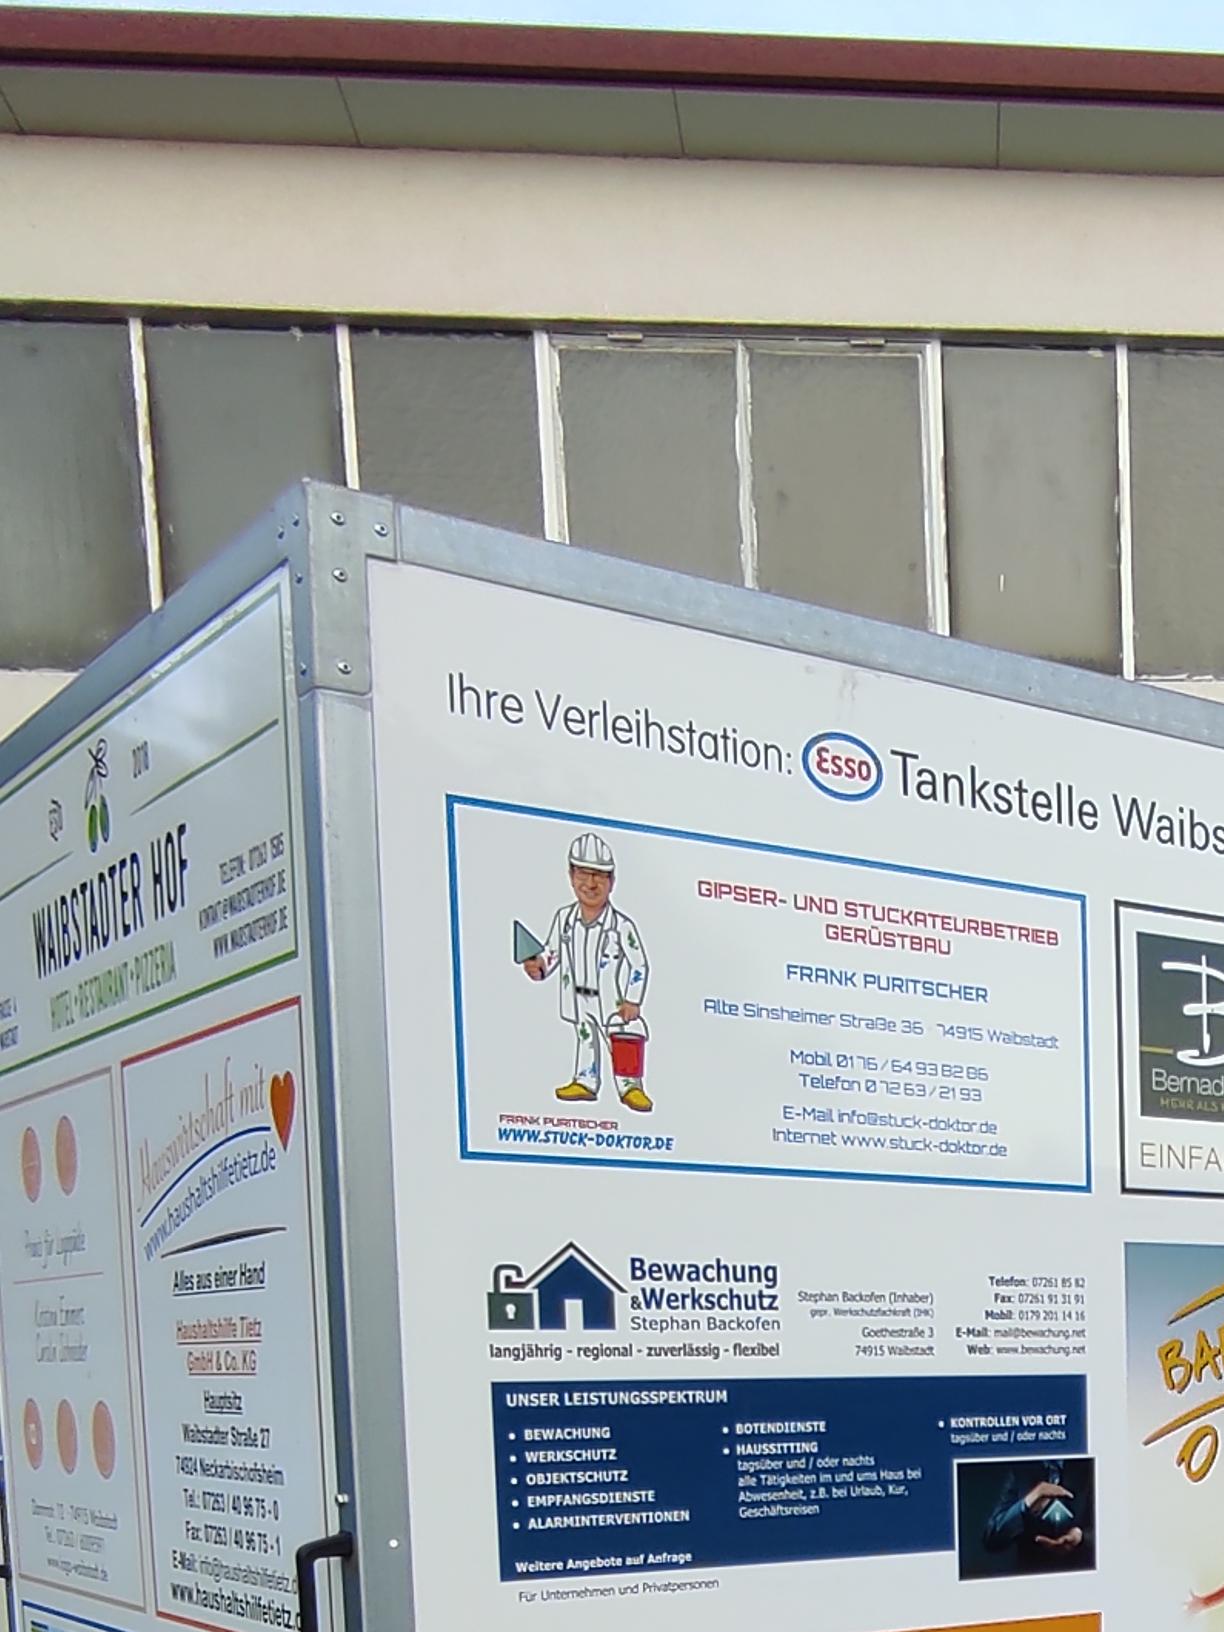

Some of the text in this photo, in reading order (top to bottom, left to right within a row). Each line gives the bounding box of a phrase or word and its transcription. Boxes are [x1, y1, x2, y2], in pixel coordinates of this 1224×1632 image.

[449, 672, 524, 723] Ihre
[535, 689, 793, 776] Verleihstation:
[891, 749, 1099, 830] Tankstelle
[32, 823, 188, 980] WAIBSTADTER HOF
[698, 880, 1059, 946] GIPSER- UND STUCKATEURBETRIEB
[826, 925, 951, 955] GERÜSTBAU
[786, 964, 988, 1002] FRANK PURITSCHER
[704, 999, 1059, 1049] Alte Sinsheimer Straße 74915 Waibstadt
[791, 1050, 833, 1067] Mobil
[240, 1063, 265, 1117] mit
[799, 1074, 860, 1093] Telefon
[499, 1114, 618, 1130] FRANK PURITSCHER
[783, 1106, 833, 1123] E-Mail
[498, 1128, 674, 1151] WWW.STUCK-DOKTOR.DE
[773, 1129, 1007, 1157] Internet www.stuck-doktor.de
[173, 1261, 266, 1293] Alles aus einer Hand
[630, 1258, 778, 1288] Bewachung
[989, 1276, 1029, 1287] Telefon:
[798, 1291, 839, 1304] Stephan
[842, 1292, 886, 1304] Backofen
[630, 1316, 780, 1333] Stephan Backofen
[187, 1351, 213, 1372] GmbH
[242, 1350, 257, 1371] KG
[490, 1343, 779, 1362] langjährig regional zuverlässig flexibel
[855, 1346, 884, 1357] 74915
[203, 1390, 242, 1412] Hauptsitz
[506, 1390, 728, 1408] UNSER LEISTUNGSSPEKTRUM
[736, 1421, 826, 1435] BOTENDIENSTE
[951, 1414, 1066, 1429] KONTROLLEN VOR ORT
[524, 1427, 611, 1441] BEWACHUNG
[525, 1449, 618, 1463] WERKSCHUTZ
[736, 1442, 818, 1456] HAUSSITTING
[738, 1455, 874, 1473] tagsüber und oder nachts
[526, 1470, 628, 1485] OBJEKTSCHUTZ
[760, 1468, 922, 1488] Tätigkeiten und bei
[527, 1490, 655, 1508] EMPFANGSDIENSTE
[528, 1510, 690, 1529] ALARMINTERVENTIONEN
[739, 1503, 820, 1519] Geschäftsreisen
[516, 1552, 692, 1573] Weitere Angebote auf Anfrage
[519, 1579, 719, 1602] Für Unternehmen und Privatpersonen
